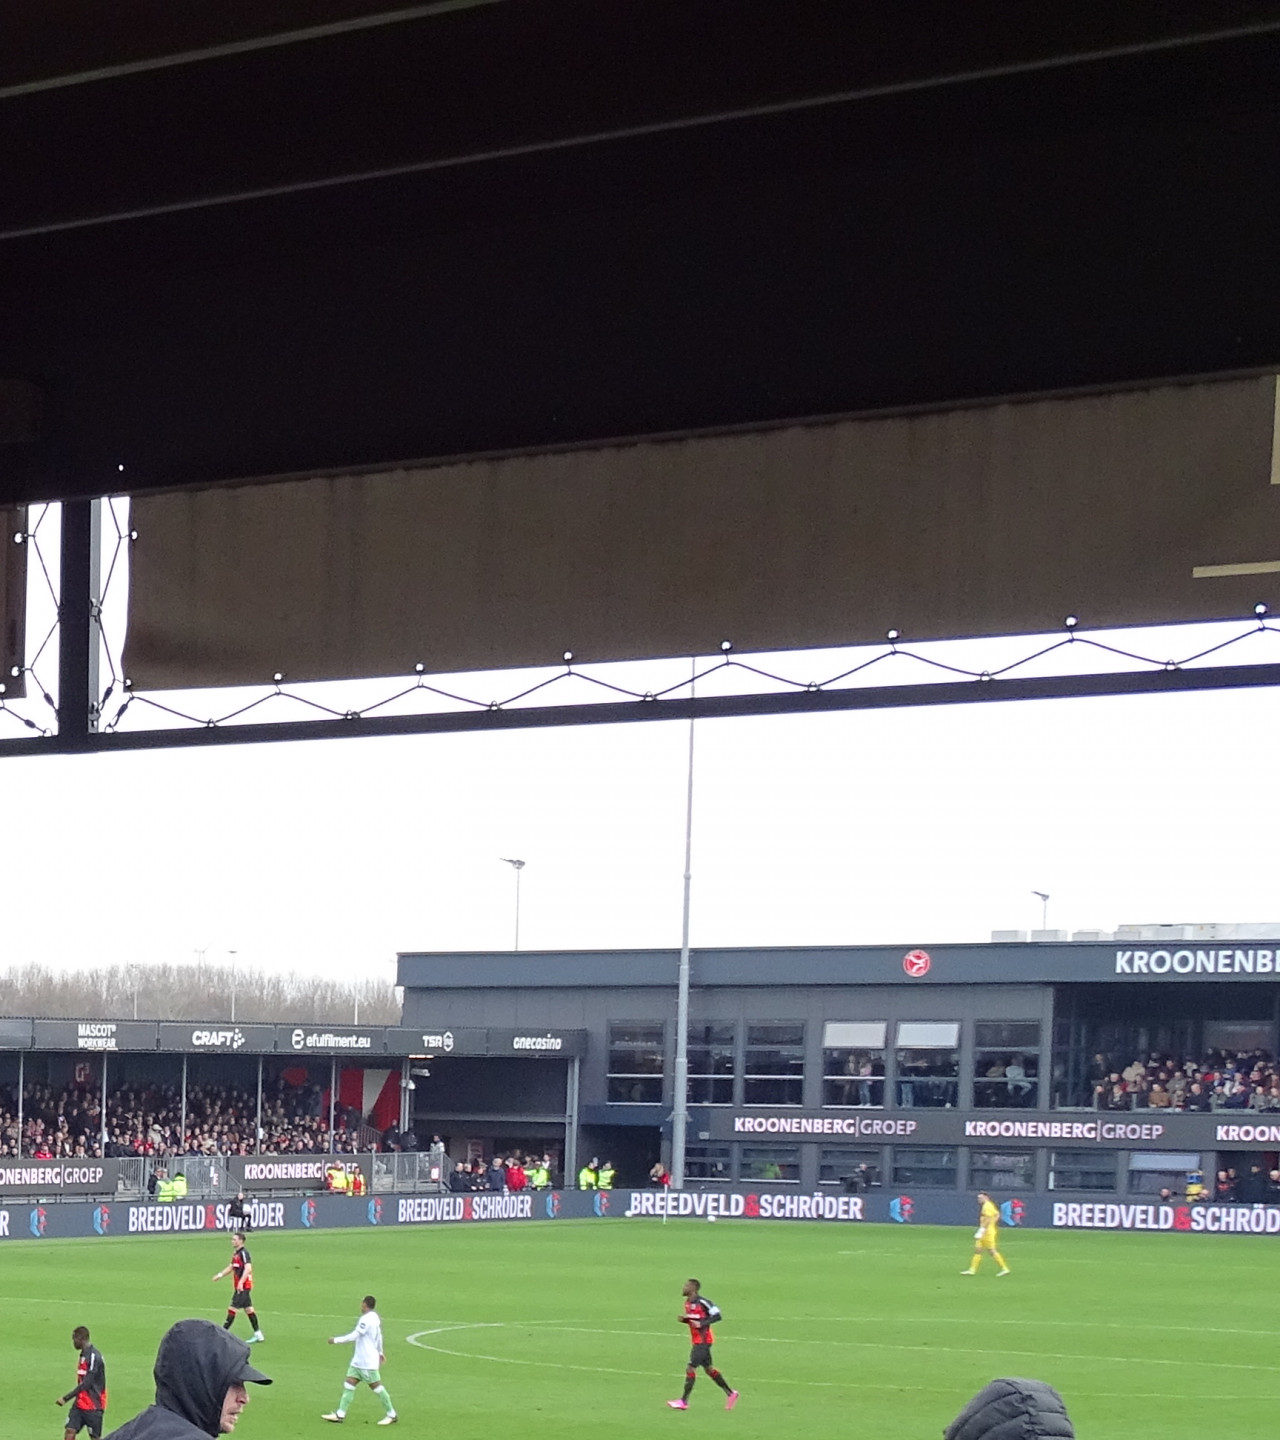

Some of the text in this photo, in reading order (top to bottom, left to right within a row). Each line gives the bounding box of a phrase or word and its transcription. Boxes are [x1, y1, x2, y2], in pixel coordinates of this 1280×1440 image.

[78, 1037, 116, 1048] WORKWEAR
[192, 1030, 235, 1046] CRAFT
[306, 1033, 371, 1049] efulfilment.eu
[734, 1117, 917, 1135] KROONENBERG GROEP
[965, 1120, 1164, 1140] KROONENBERG GROEP
[64, 1167, 104, 1184] GROEP
[244, 1162, 321, 1180] KROONENBERG
[629, 1192, 864, 1220] BREEDVELD&SCHRÖDER
